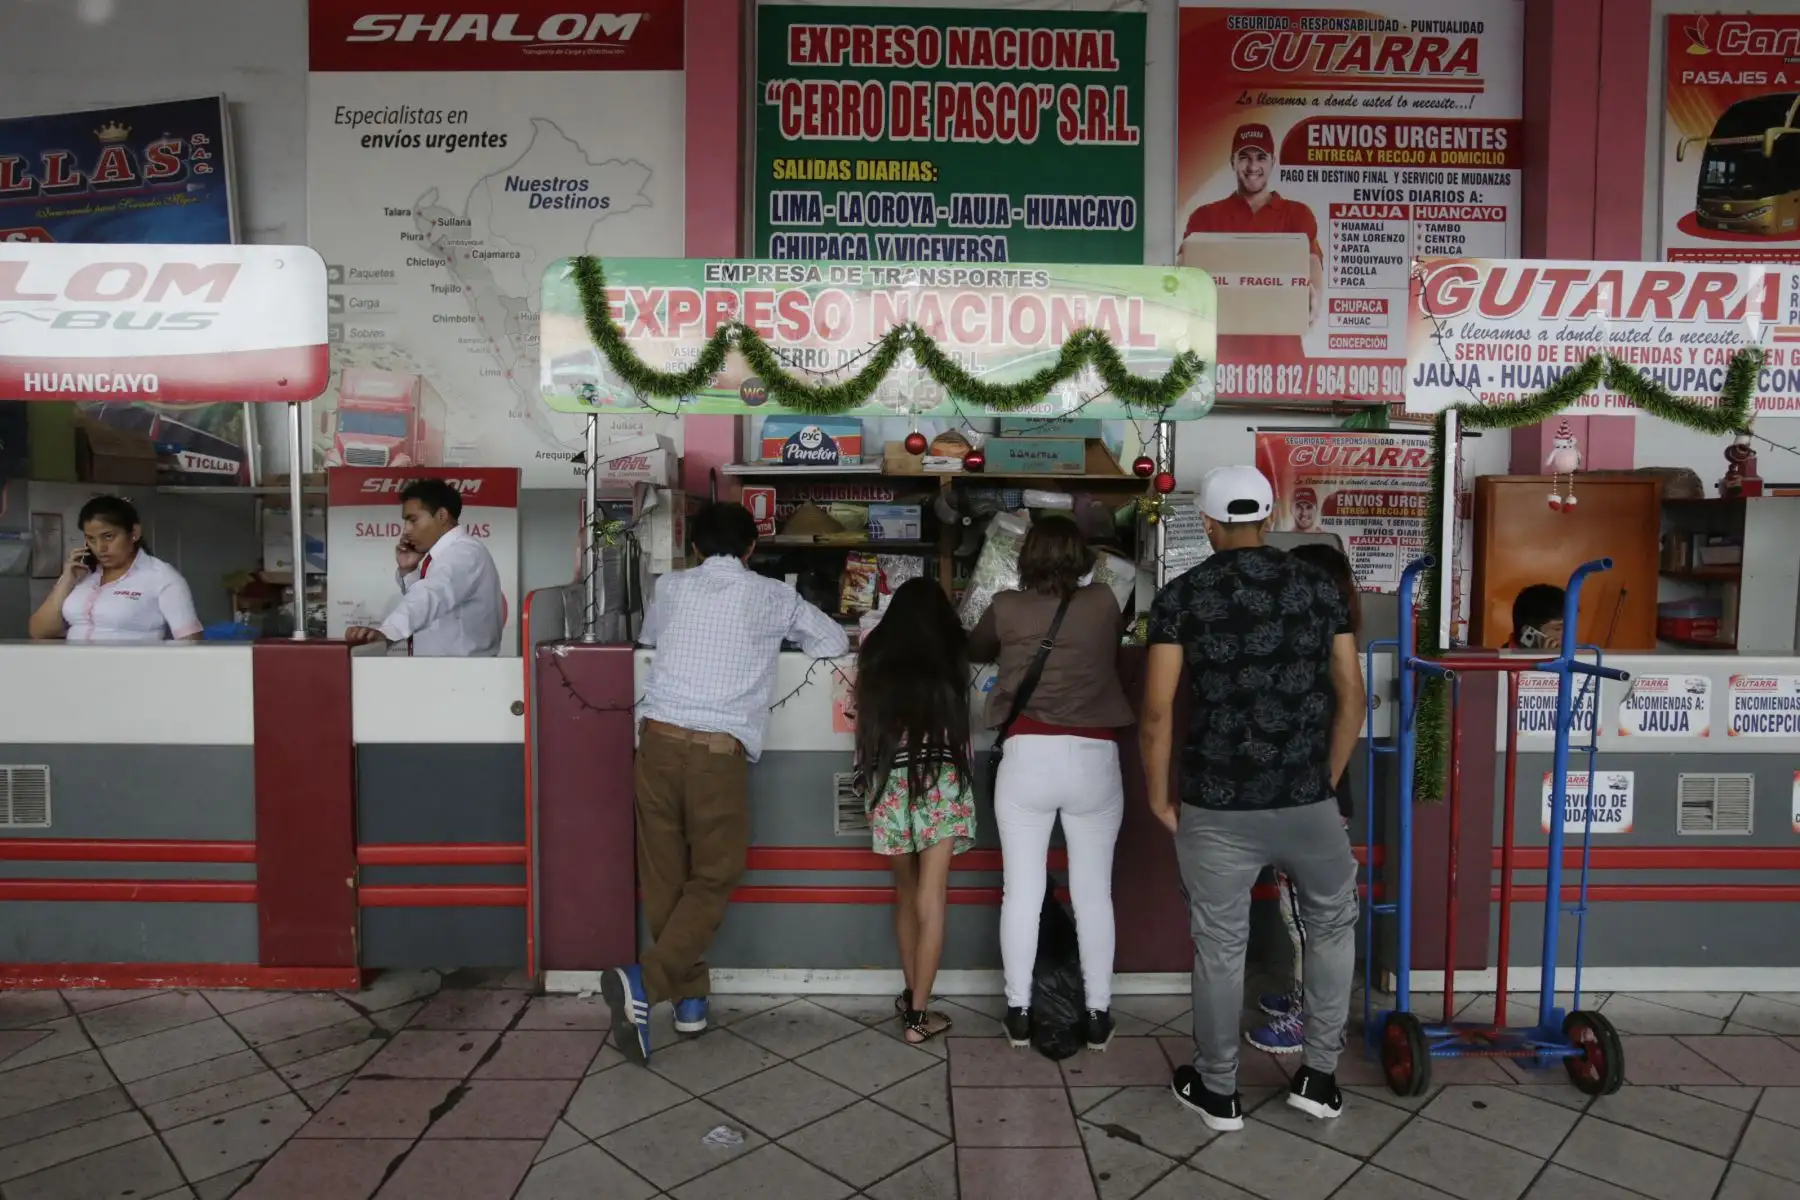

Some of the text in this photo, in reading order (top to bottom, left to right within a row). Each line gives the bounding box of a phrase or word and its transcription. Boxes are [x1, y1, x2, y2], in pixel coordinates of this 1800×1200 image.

[346, 13, 642, 41] SHALOM
[1228, 16, 1484, 34] SEGURIDAD RESPONSABILIDAD PUNTUALIDAD
[789, 25, 1118, 70] EXPRESO NACIONAL
[1231, 31, 1480, 76] GUTARRA
[1682, 71, 1788, 84] PASAJES A
[1257, 93, 1308, 107] llevamos
[1312, 98, 1320, 107] a
[1324, 95, 1358, 108] donde
[1362, 96, 1392, 109] usted
[1398, 96, 1408, 109] lo
[334, 105, 468, 129] Especialistas en
[890, 82, 930, 141] DE
[1057, 85, 1140, 145] S.R.L.
[360, 129, 508, 152] envíos urgentes
[1308, 125, 1508, 150] ENVIOS URGENTES
[1308, 149, 1505, 164] ENTREGA Y RECOJO A DOMICILIO
[773, 159, 938, 182] SALIDAS DIARIAS:
[1280, 170, 1510, 186] PAGO EN DESTINO FINAL Y SERVICIO DE MUDANZAS
[504, 176, 611, 210] Nuestros Destinos
[1354, 186, 1484, 203] ENVÍOS DIARIOS A:
[384, 208, 411, 216] Talara
[770, 191, 1136, 230] LIMA LA OROYA JAUJA HUANCAYO
[1336, 205, 1504, 220] JAUJA HUANCAYO
[438, 218, 472, 227] Sullana
[1425, 224, 1461, 232] TAMBO
[400, 232, 424, 242] Piura
[1341, 234, 1405, 242] SAN LORENZO
[1425, 234, 1466, 244] CENTRO
[770, 233, 868, 260] CHUPACA
[893, 235, 1008, 262] VICEVERSA
[1341, 244, 1370, 253] APATA
[1425, 246, 1462, 254] CHILCA
[472, 250, 520, 260] Cajamarca
[406, 258, 446, 268] Chiclayo
[349, 268, 394, 280] Paquetes
[704, 264, 1050, 288] EMPRESA DE TRANSPORTES
[1341, 266, 1377, 275] ACOLLA
[1240, 277, 1284, 286] FRAGIL
[1340, 278, 1366, 286] PACA
[430, 284, 462, 294] Trujillo
[1422, 264, 1781, 324] GUTARRA
[349, 298, 380, 309] Carga
[1334, 300, 1383, 312] CHUPACA
[432, 314, 476, 324] Chimbote
[605, 288, 1156, 350] EXPRESO NACIONAL
[1343, 317, 1370, 326] AHUAC
[350, 328, 385, 339] Sobres
[1460, 323, 1532, 342] llevamos
[1538, 331, 1549, 341] a
[1556, 324, 1602, 342] donde
[1608, 327, 1653, 343] usted
[1658, 326, 1674, 343] lo
[1455, 344, 1532, 362] SERVICIO
[1538, 345, 1558, 363] DE
[1563, 346, 1682, 365] ENCMIENDAS
[1688, 347, 1698, 365] Y
[480, 368, 501, 377] Lima
[1414, 363, 1481, 389] JAUJA
[24, 372, 158, 393] HUANCAYO
[1216, 364, 1242, 393] 981
[1246, 365, 1274, 394] 818
[1276, 365, 1302, 394] 812
[1316, 365, 1344, 395] 964
[1350, 366, 1378, 396] 909
[744, 386, 765, 400] WC
[786, 444, 838, 460] Panetón
[184, 455, 235, 473] TICLLAS
[1337, 494, 1383, 508] ENVIOS
[1364, 526, 1394, 536] ENVÍOS
[1352, 537, 1394, 545] JAUJA
[1626, 696, 1704, 710] ENCOMIENDAS A:
[1518, 710, 1593, 731] HUANAYO
[1639, 711, 1690, 732] JAUJA
[1612, 794, 1627, 808] DE
[1564, 808, 1622, 822] UDANZAS
